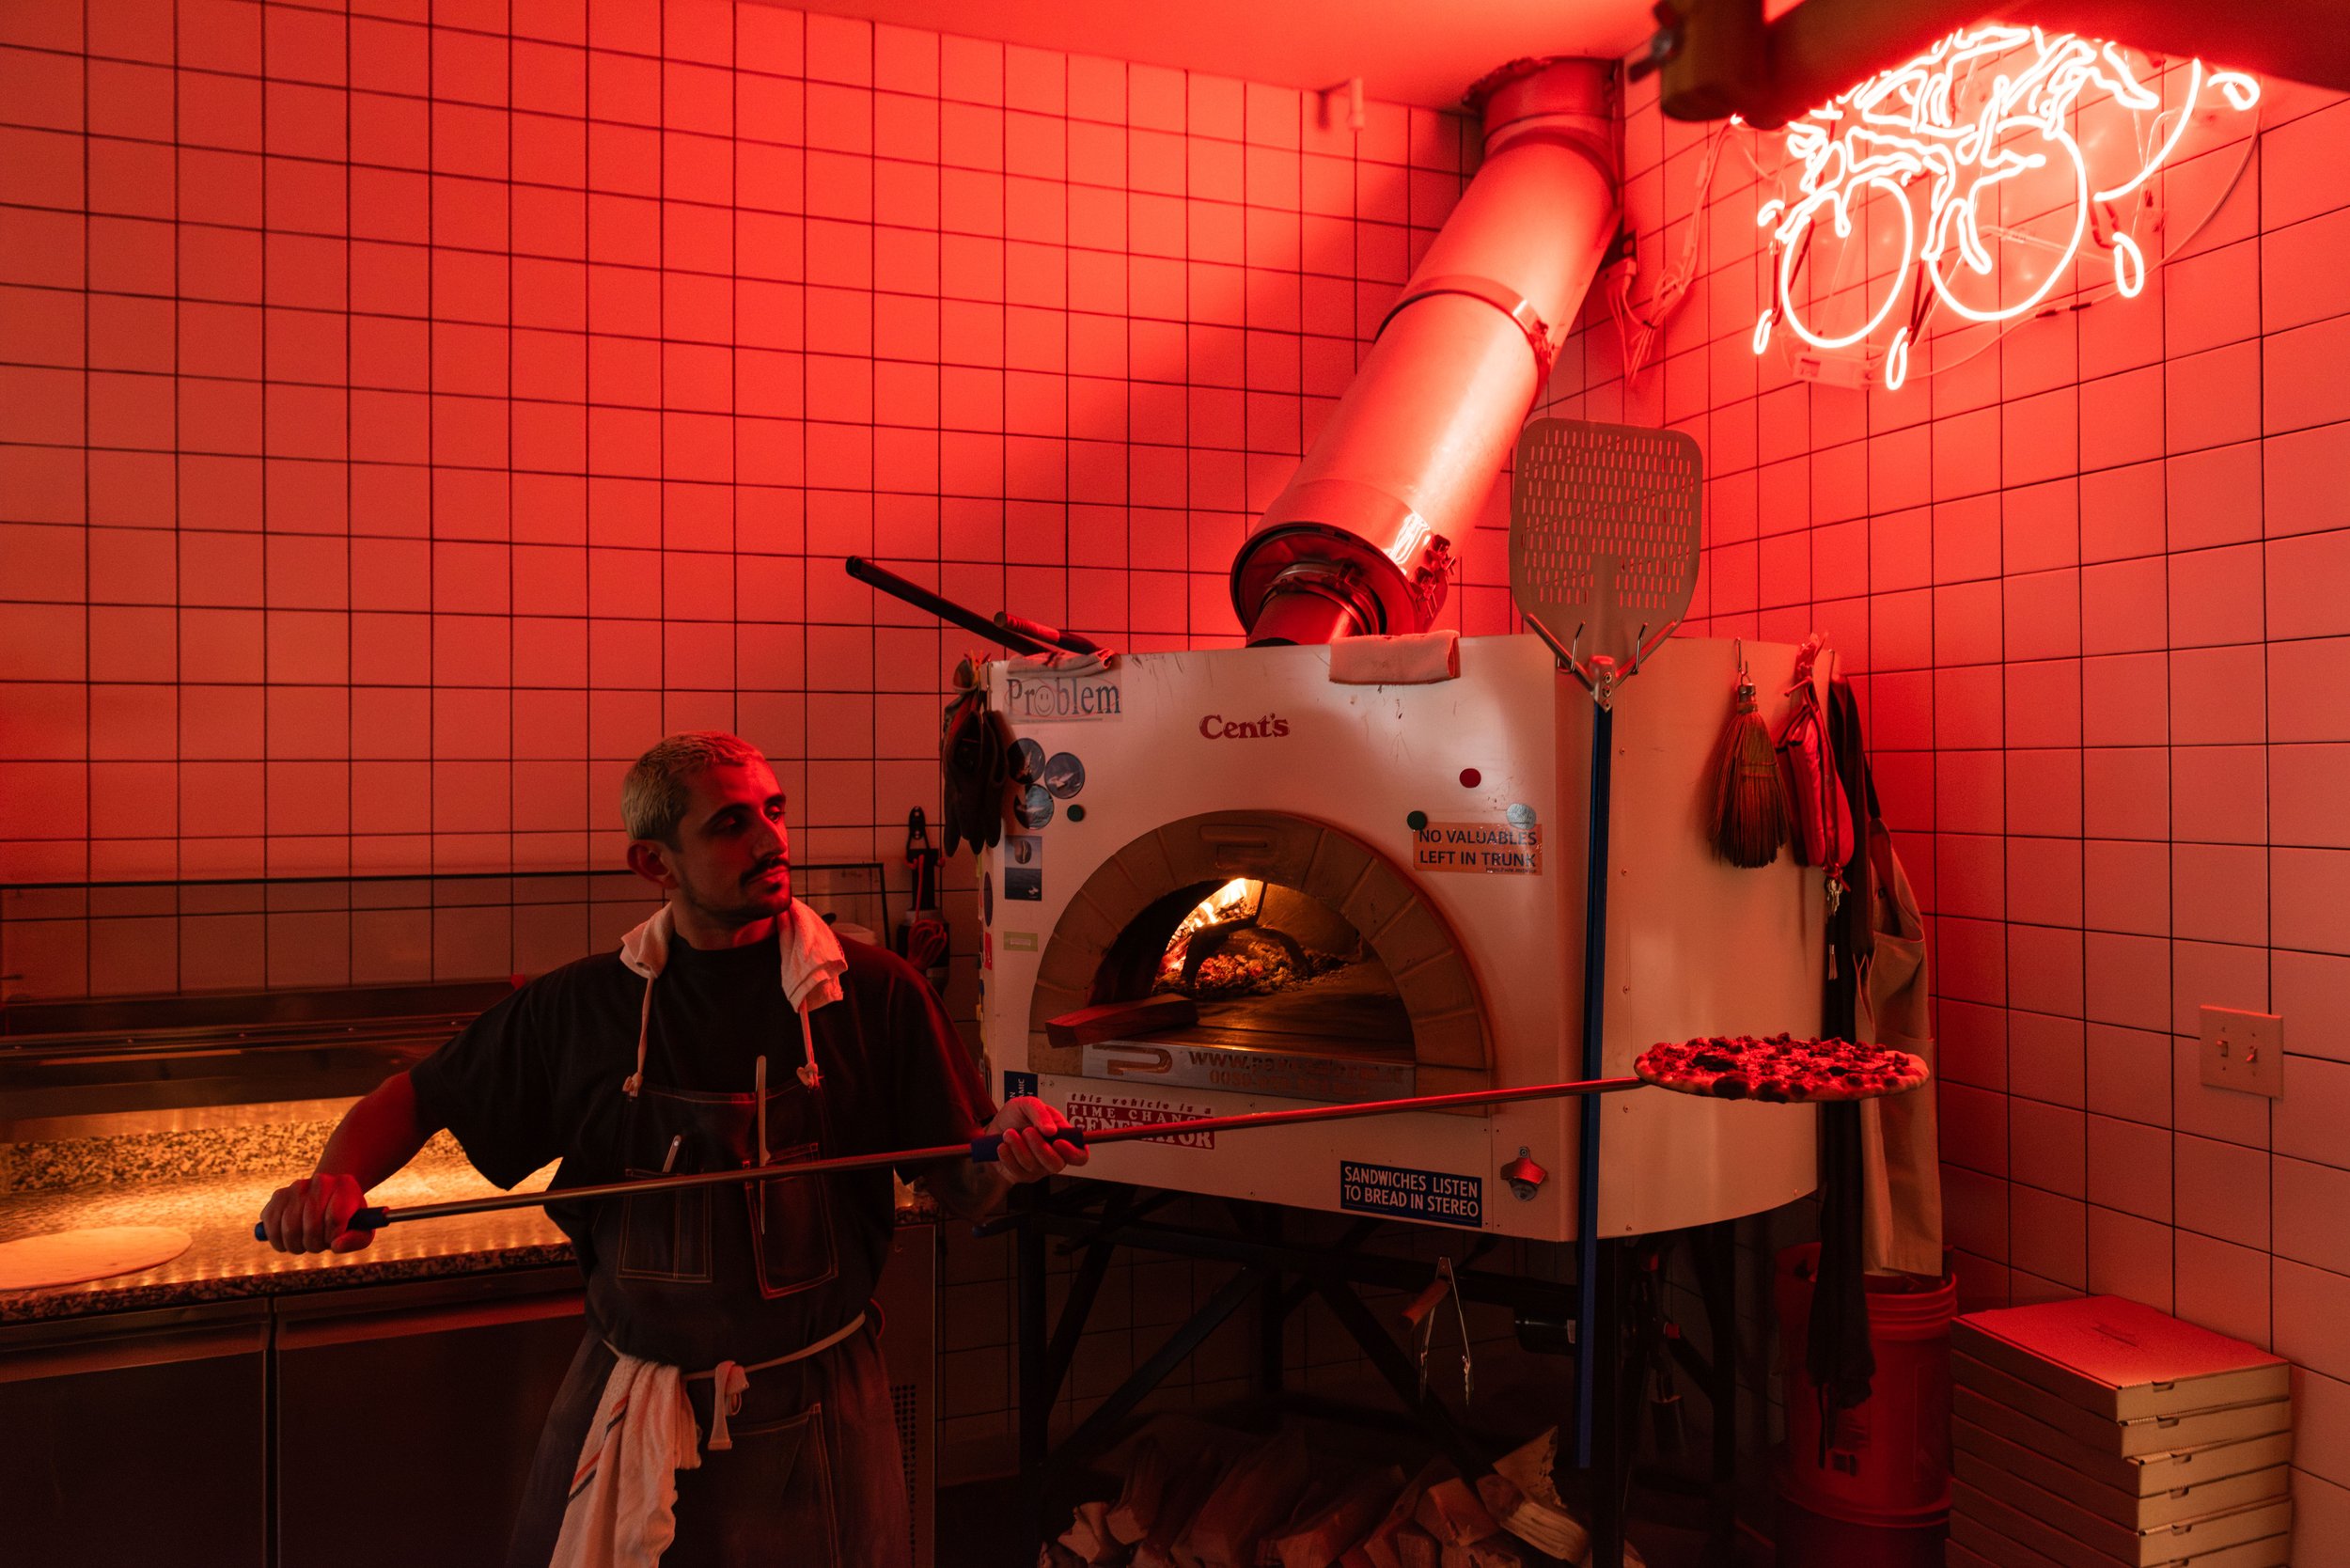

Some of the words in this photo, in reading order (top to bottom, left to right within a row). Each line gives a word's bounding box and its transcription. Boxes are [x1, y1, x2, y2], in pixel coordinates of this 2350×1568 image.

[1198, 712, 1291, 740] Cent's
[1419, 829, 1442, 843] NO
[1446, 829, 1538, 845] VALUABLES
[1419, 850, 1456, 864] LEFT
[1461, 851, 1477, 865] IN
[1480, 852, 1537, 867] TRUNK
[1071, 1092, 1103, 1104] this
[1112, 1097, 1170, 1110] vehicle
[1179, 1103, 1195, 1113] is
[1069, 1104, 1117, 1119] TIME
[1128, 1109, 1213, 1124] CHAN
[1344, 1166, 1427, 1192] SANDWICHES
[1433, 1176, 1479, 1199] LISTEN
[1344, 1184, 1361, 1201] TO
[1364, 1187, 1407, 1208] BREAD
[1410, 1193, 1424, 1210] IN
[1427, 1195, 1480, 1217] STEREO
